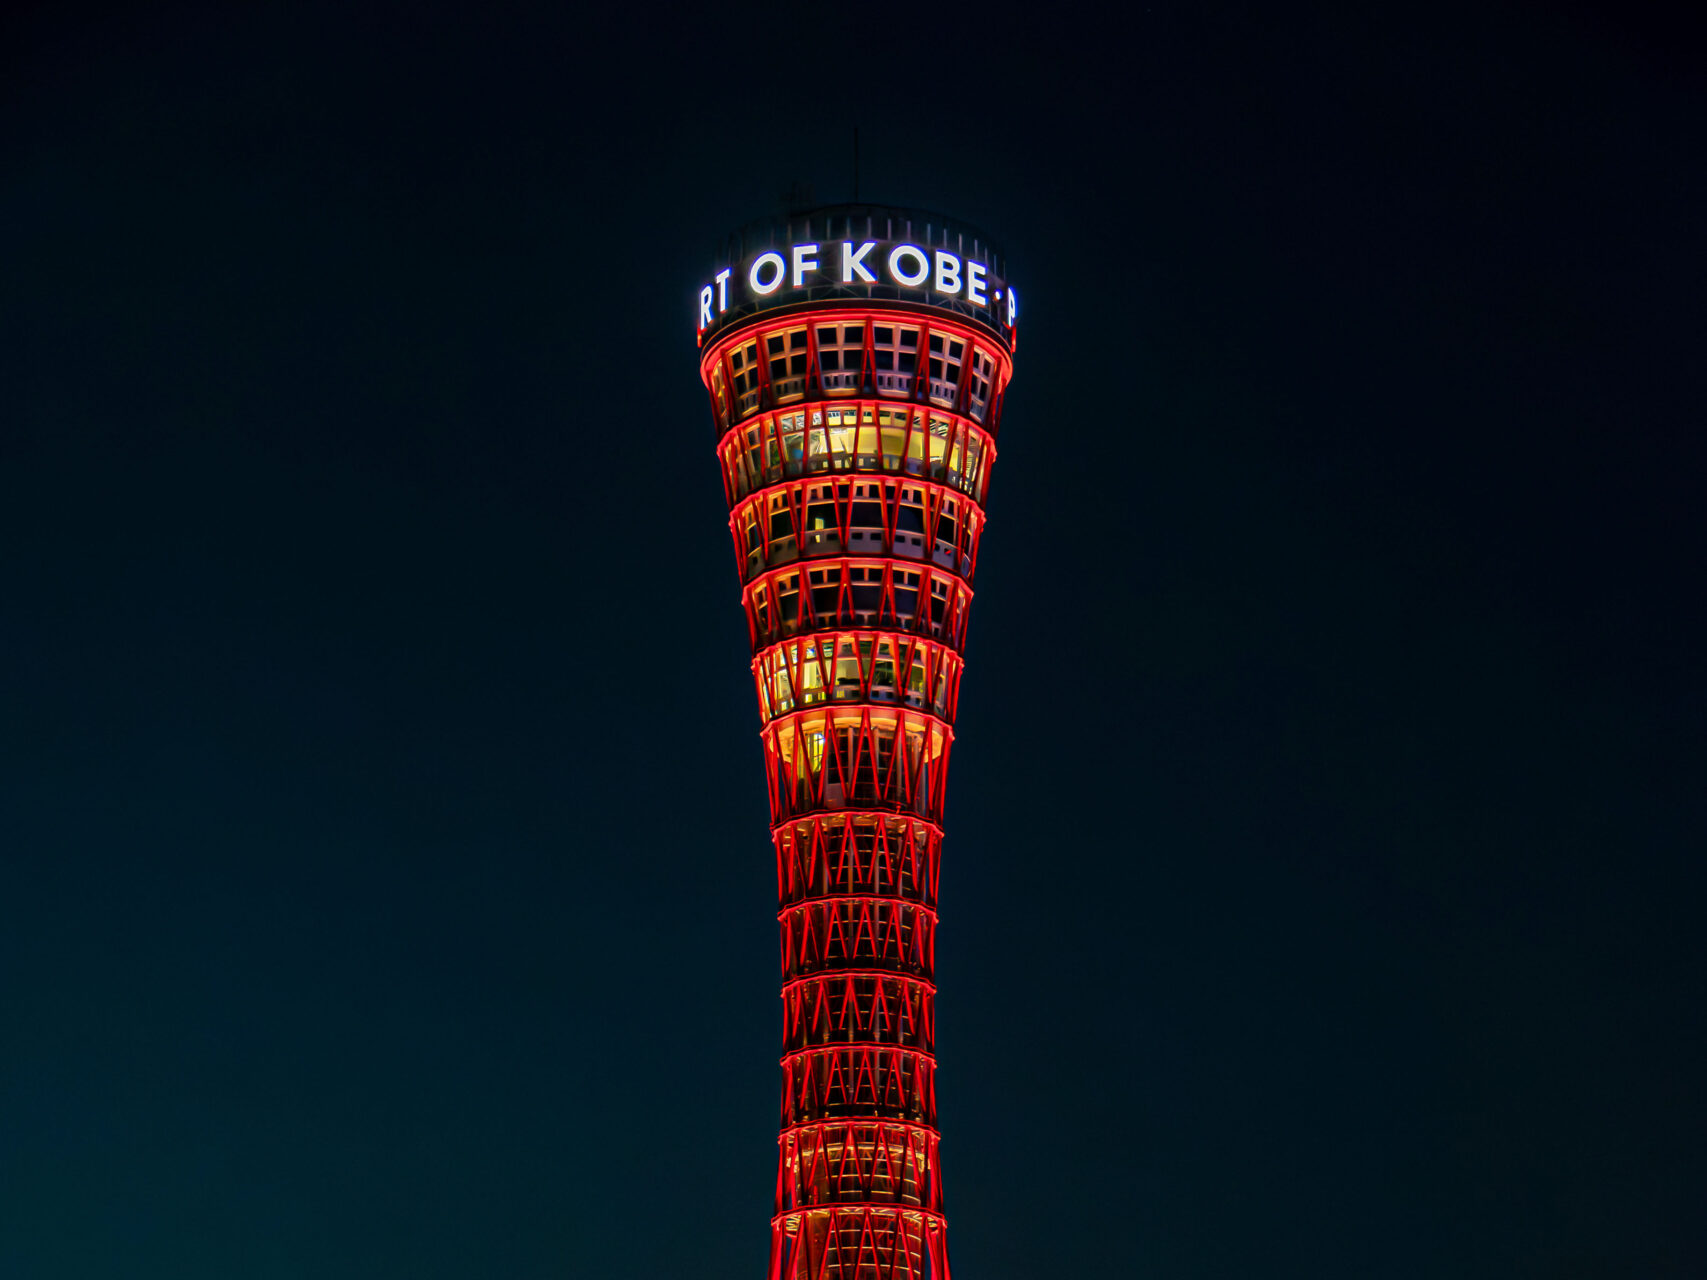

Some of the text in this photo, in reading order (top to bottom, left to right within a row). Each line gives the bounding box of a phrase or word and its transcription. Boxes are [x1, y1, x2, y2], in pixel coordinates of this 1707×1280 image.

[699, 266, 732, 332] RT
[748, 243, 821, 296] OF
[841, 240, 989, 307] KOBE
